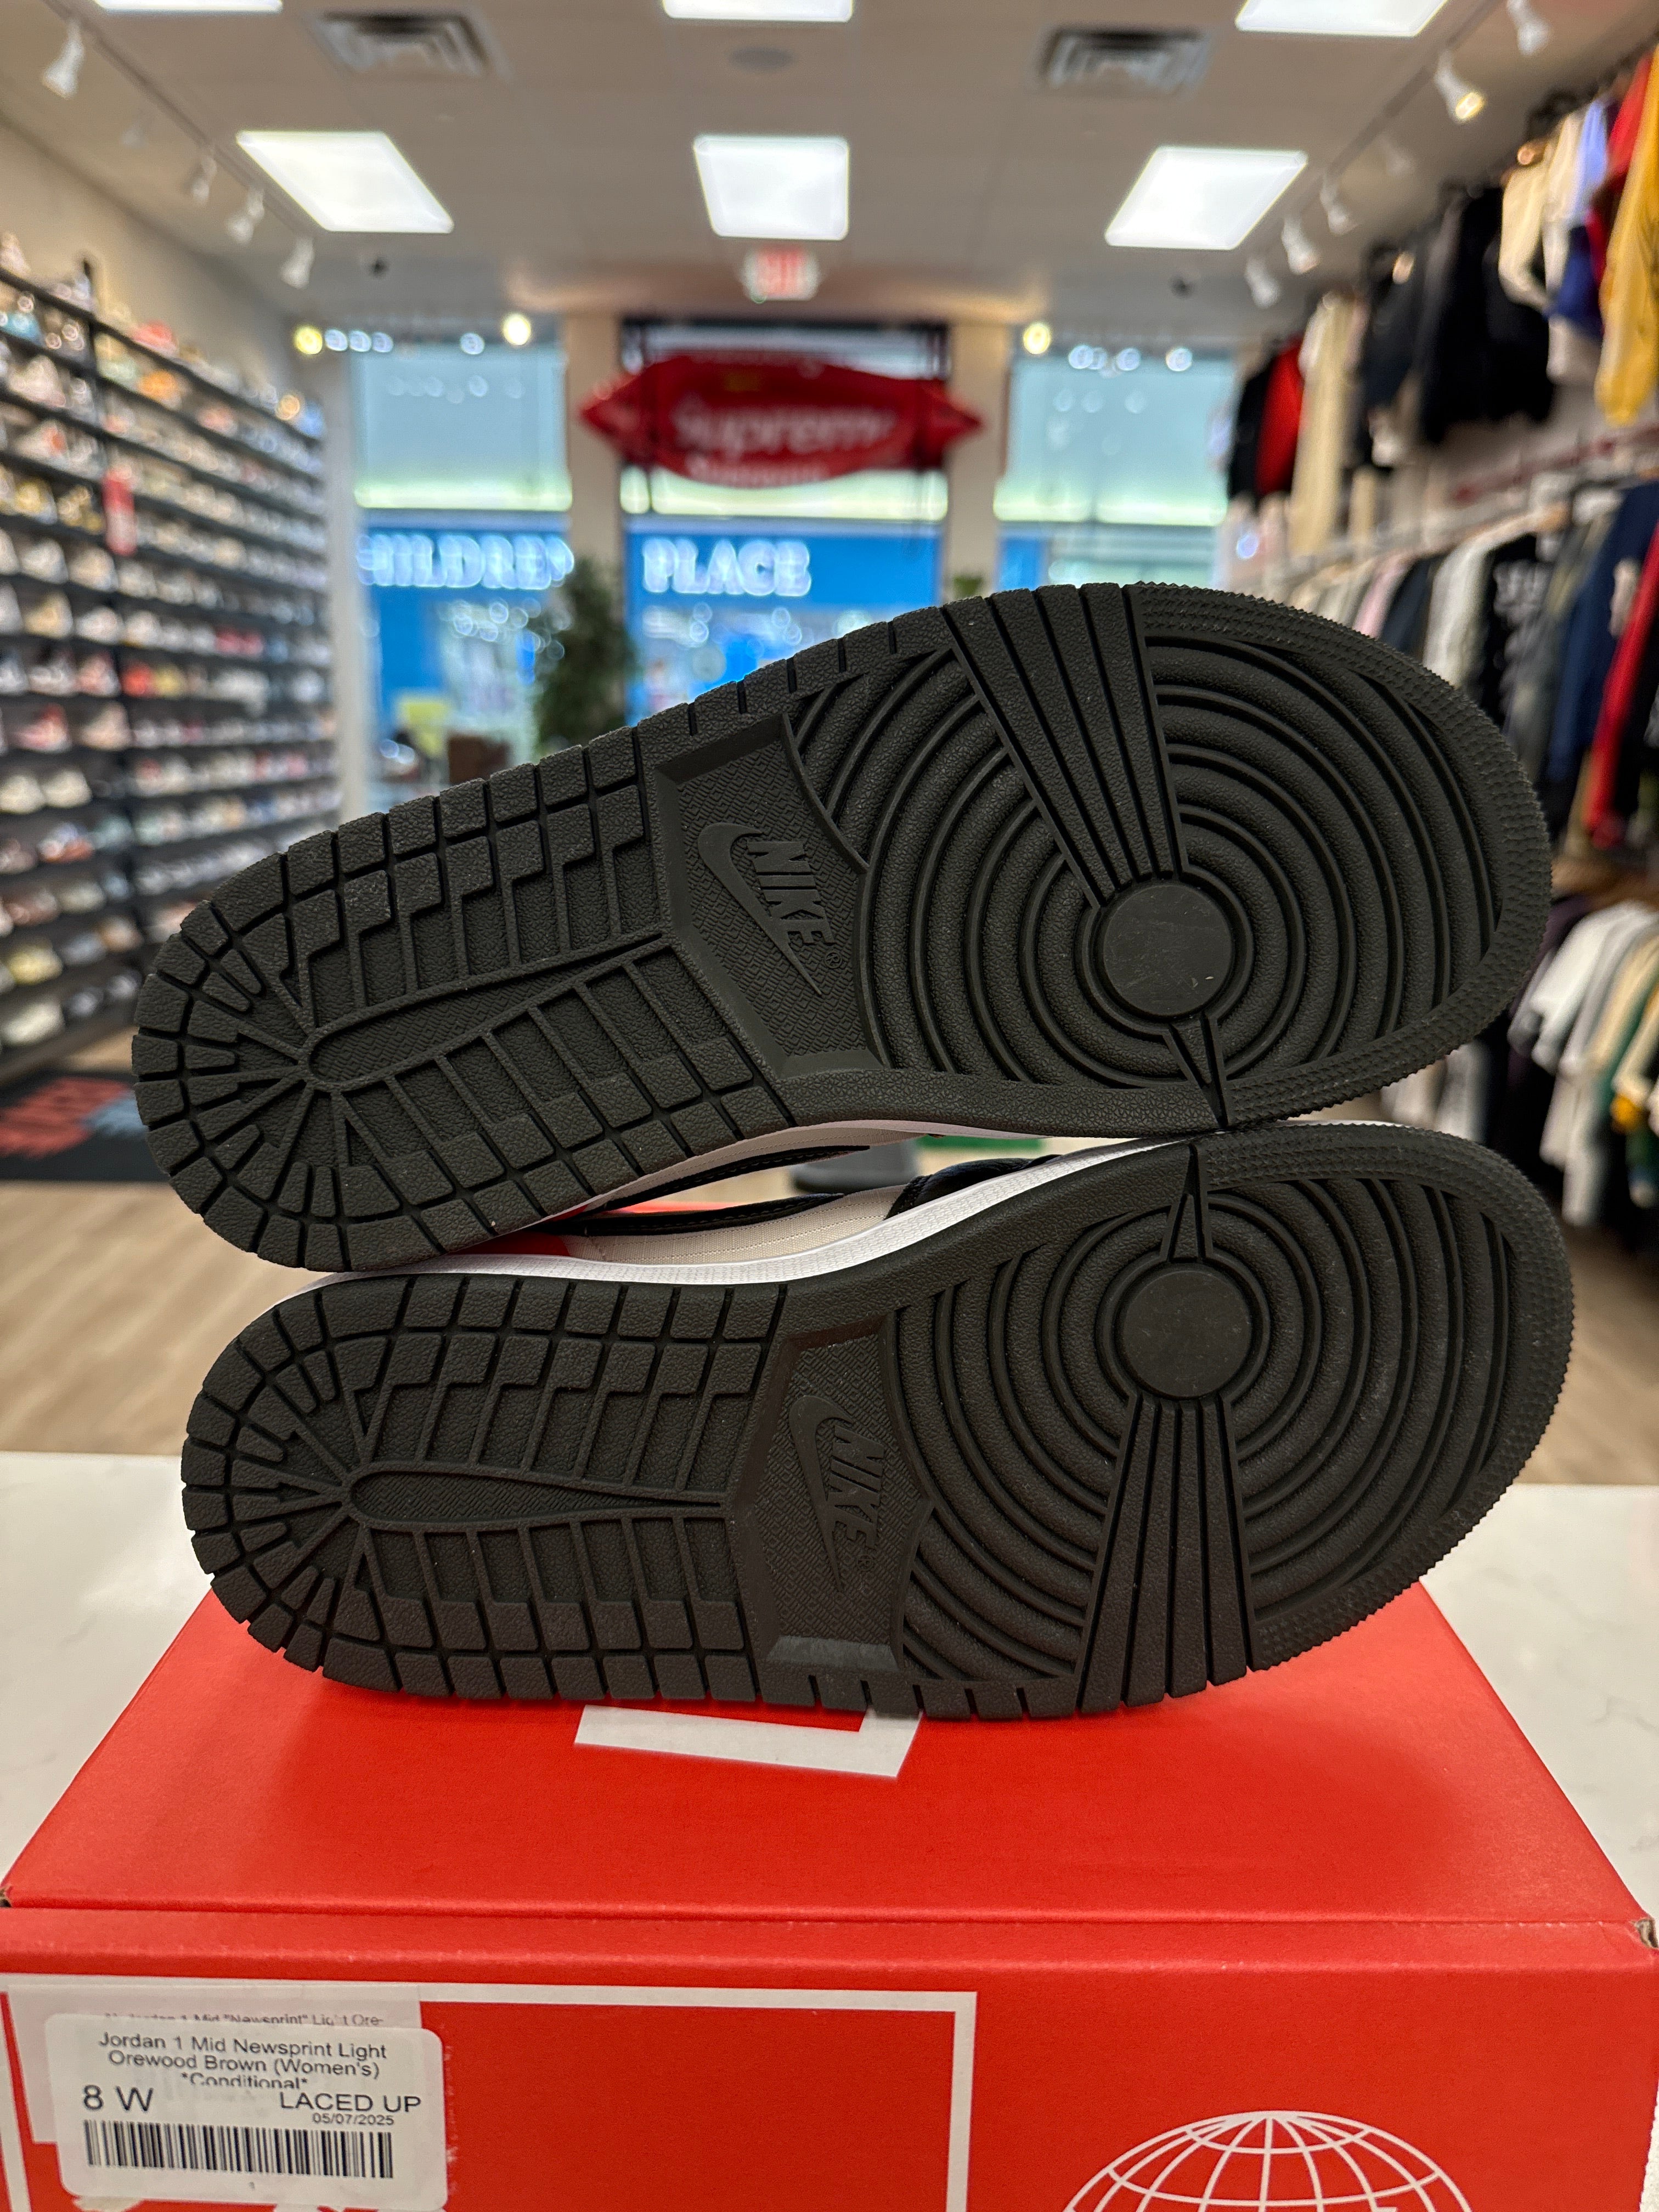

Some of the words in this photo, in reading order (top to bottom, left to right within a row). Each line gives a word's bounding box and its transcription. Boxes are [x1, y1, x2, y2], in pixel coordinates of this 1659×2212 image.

[643, 538, 812, 596] PLACE
[747, 840, 836, 944] NIKE
[827, 1425, 884, 1549] NIKE
[99, 2032, 166, 2049] Jordan
[174, 2035, 183, 2050] 1
[191, 2036, 226, 2052] Mid
[233, 2038, 331, 2058] Newsprint
[338, 2042, 387, 2061] Light
[109, 2049, 198, 2068] Orewood
[204, 2055, 267, 2072] Brown
[274, 2057, 380, 2080] (Women's)
[83, 2084, 104, 2111] 8
[115, 2085, 154, 2112] W
[280, 2091, 374, 2112] LACED
[383, 2094, 422, 2113] UP
[312, 2112, 394, 2126] 05/07/2025
